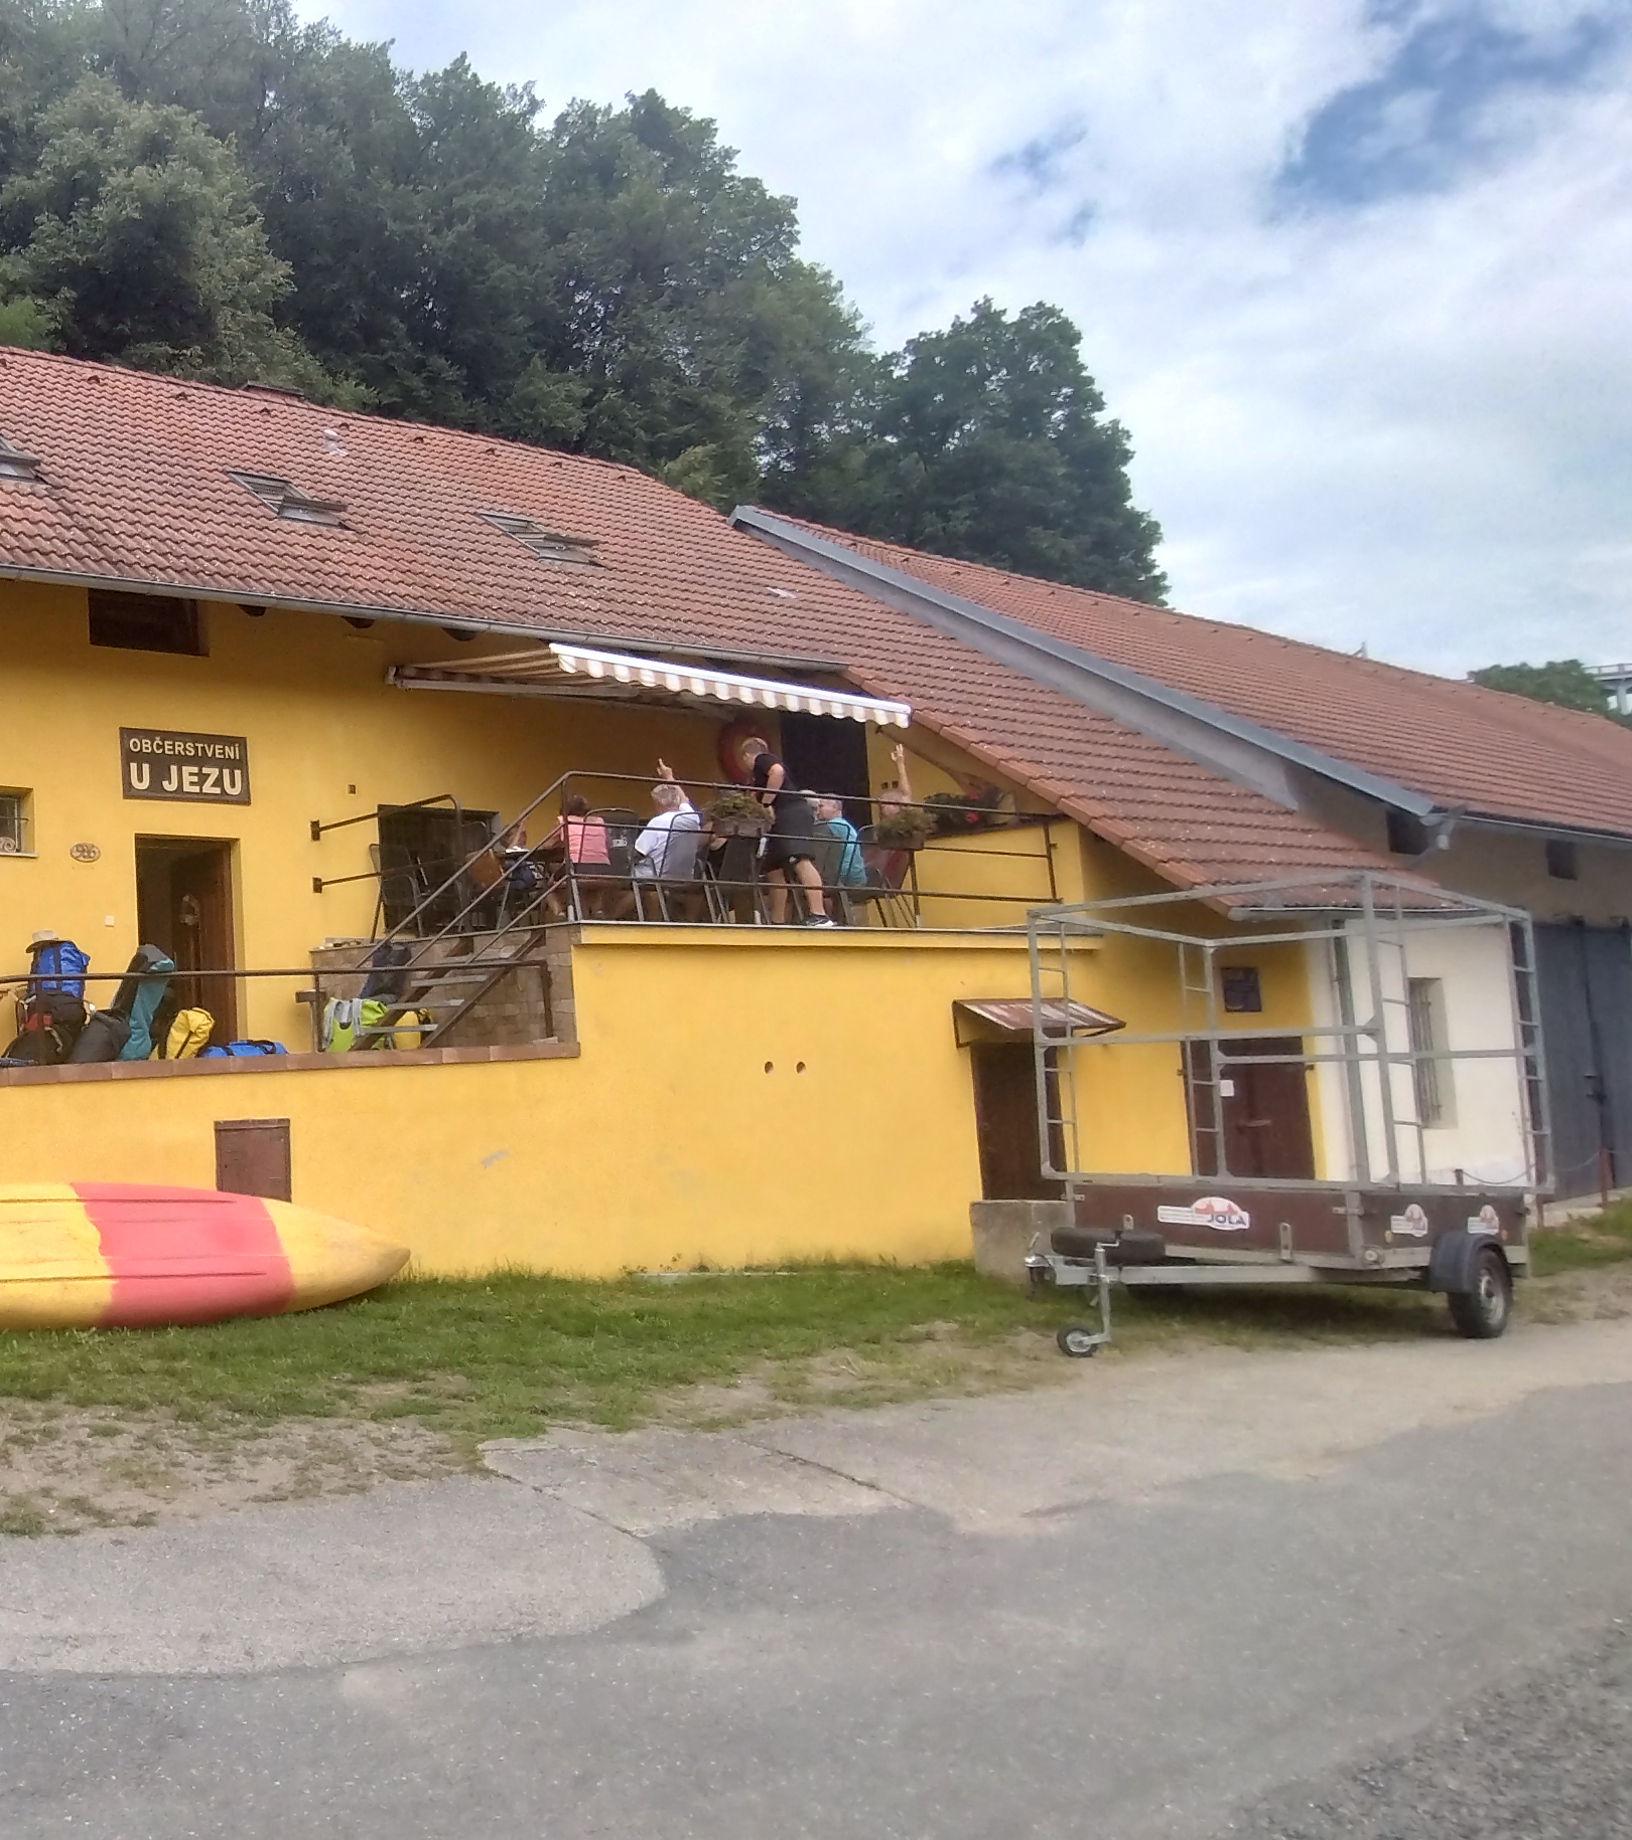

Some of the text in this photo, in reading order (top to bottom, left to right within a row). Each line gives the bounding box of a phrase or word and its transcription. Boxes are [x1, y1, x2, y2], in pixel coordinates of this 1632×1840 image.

[129, 736, 240, 759] OBČERSTVENÍ
[129, 762, 242, 796] U JEZU
[1208, 1213, 1247, 1226] JOLA
